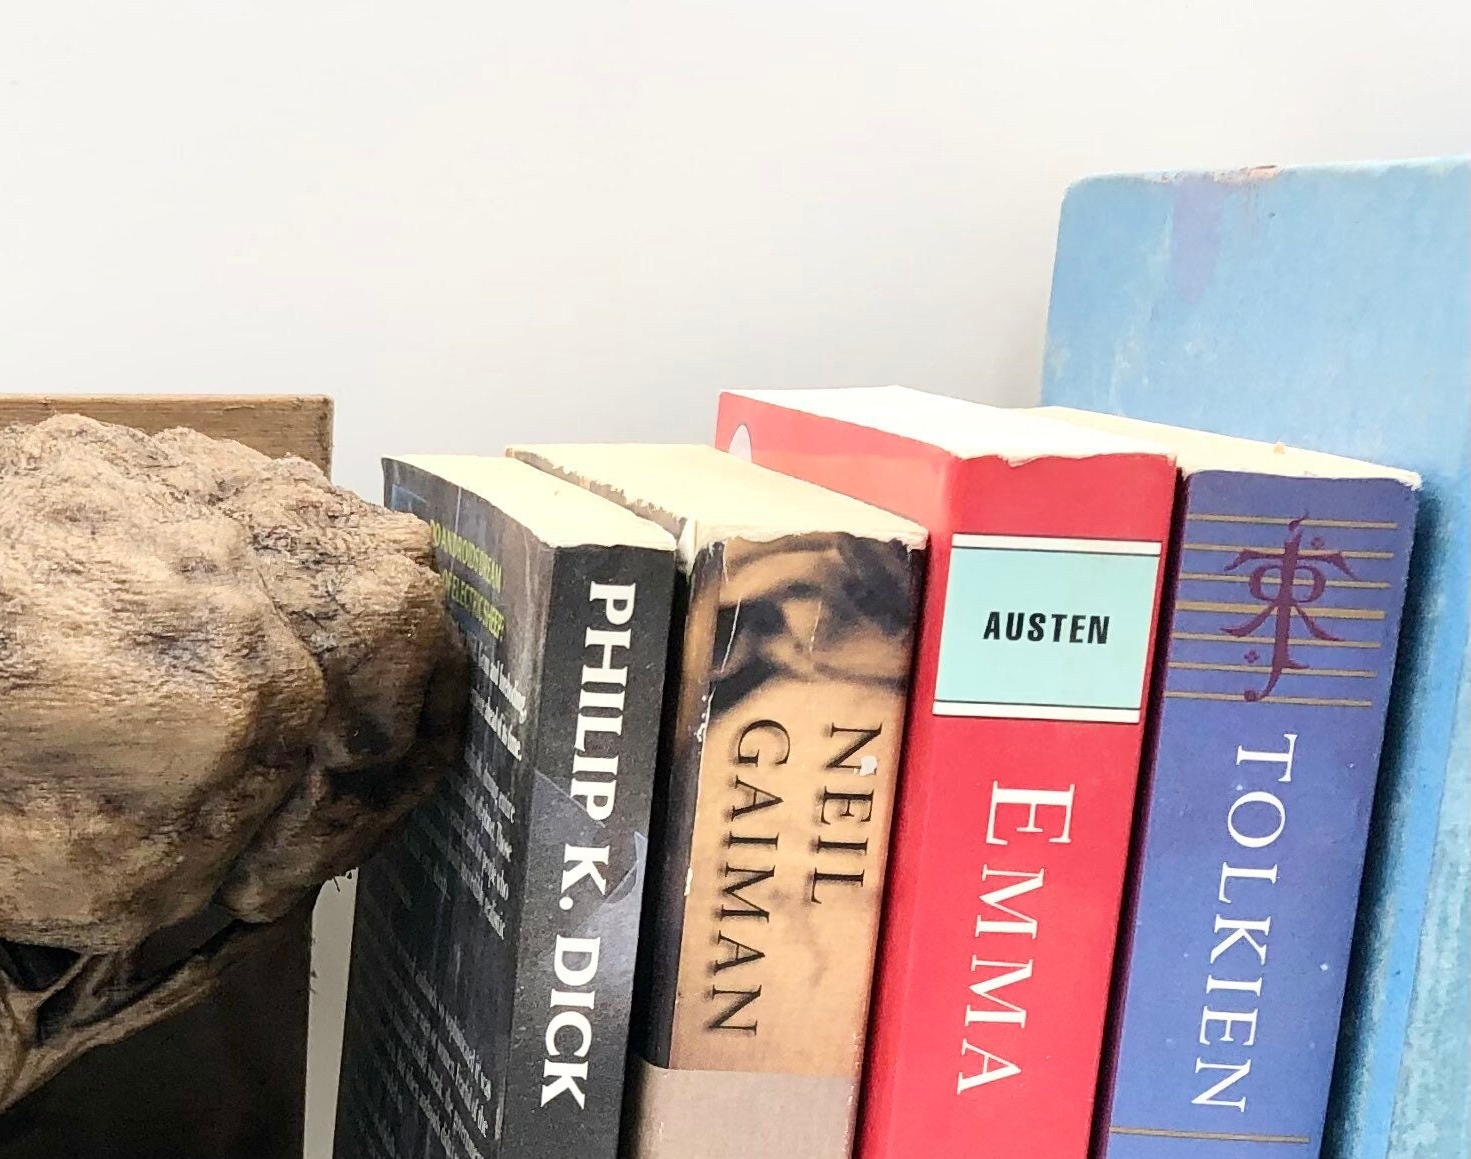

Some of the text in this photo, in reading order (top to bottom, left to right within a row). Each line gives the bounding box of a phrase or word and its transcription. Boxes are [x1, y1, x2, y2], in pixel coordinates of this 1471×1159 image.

[983, 610, 1111, 645] AUSTEN
[540, 580, 637, 1111] PHILIP K. DICK
[707, 719, 791, 1037] GAIMAN
[811, 722, 883, 905] NEIL
[957, 780, 1076, 1096] EMMA
[1191, 732, 1299, 1113] TOLKIEN
